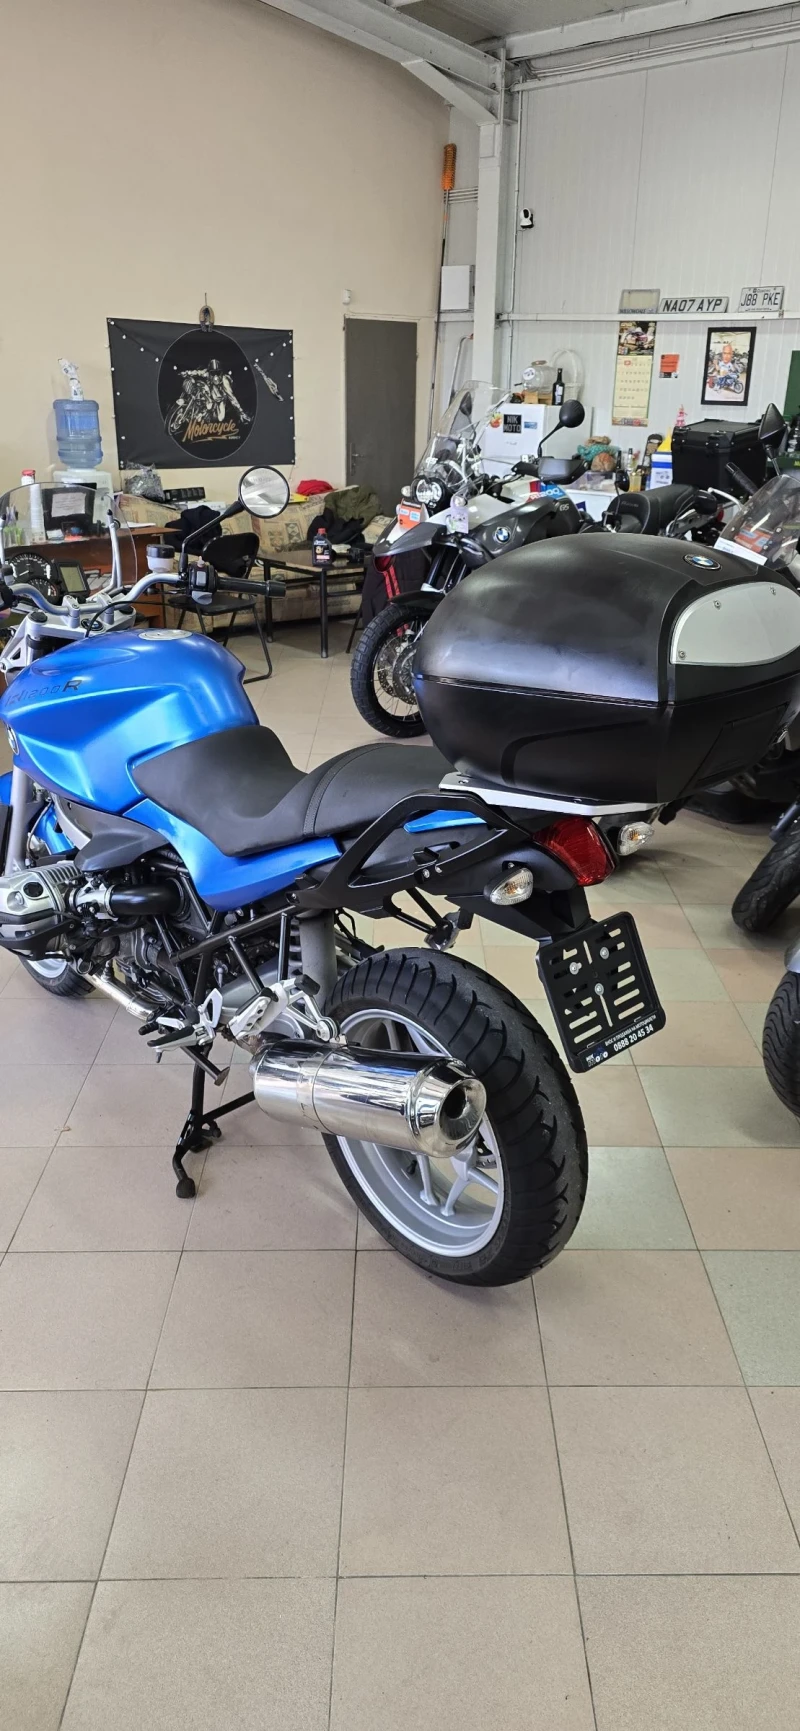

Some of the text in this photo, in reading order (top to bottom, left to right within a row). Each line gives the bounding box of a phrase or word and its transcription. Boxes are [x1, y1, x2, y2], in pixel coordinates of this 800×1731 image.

[662, 299, 696, 312] NA07
[696, 298, 723, 312] AYP
[740, 292, 781, 307] J88 PKE
[506, 416, 519, 424] NIK
[182, 419, 239, 442] Motorcycle
[503, 424, 521, 433] MOTO
[613, 1024, 653, 1051] 0888 20 45 34
